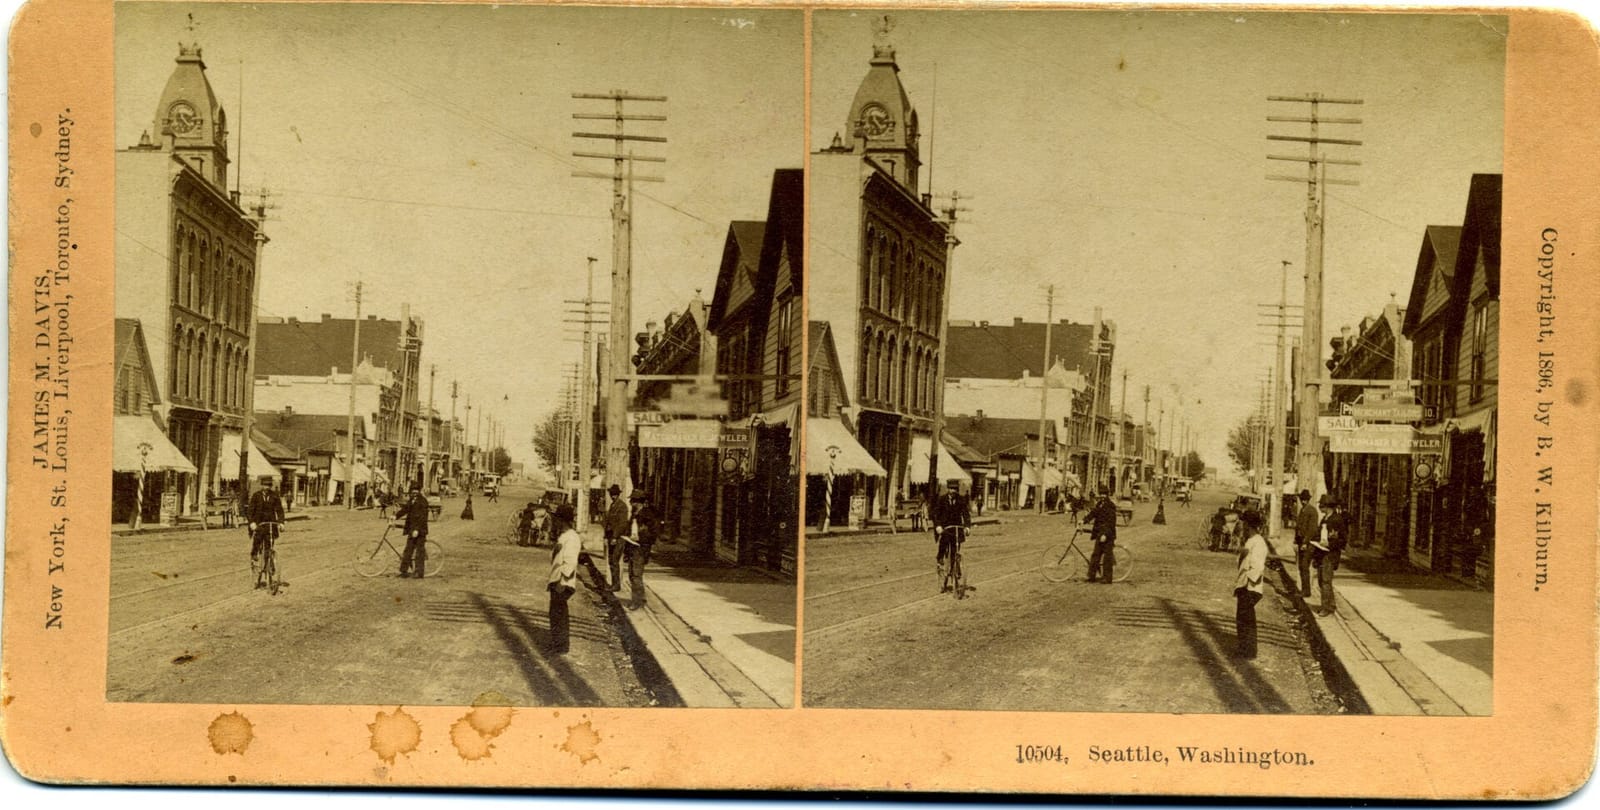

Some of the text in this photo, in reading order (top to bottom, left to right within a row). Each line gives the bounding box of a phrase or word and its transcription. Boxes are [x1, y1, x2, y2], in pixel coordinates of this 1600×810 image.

[32, 270, 53, 469] JAMES M. DAVIS,
[45, 108, 75, 630] New York, St. Louis, Liverpool, Toronto, Sydney.
[1533, 228, 1559, 592] Copyright, 1896, by B. W. Kilburn.
[1087, 745, 1169, 766] Seattle,
[1177, 747, 1314, 770] Washington.
